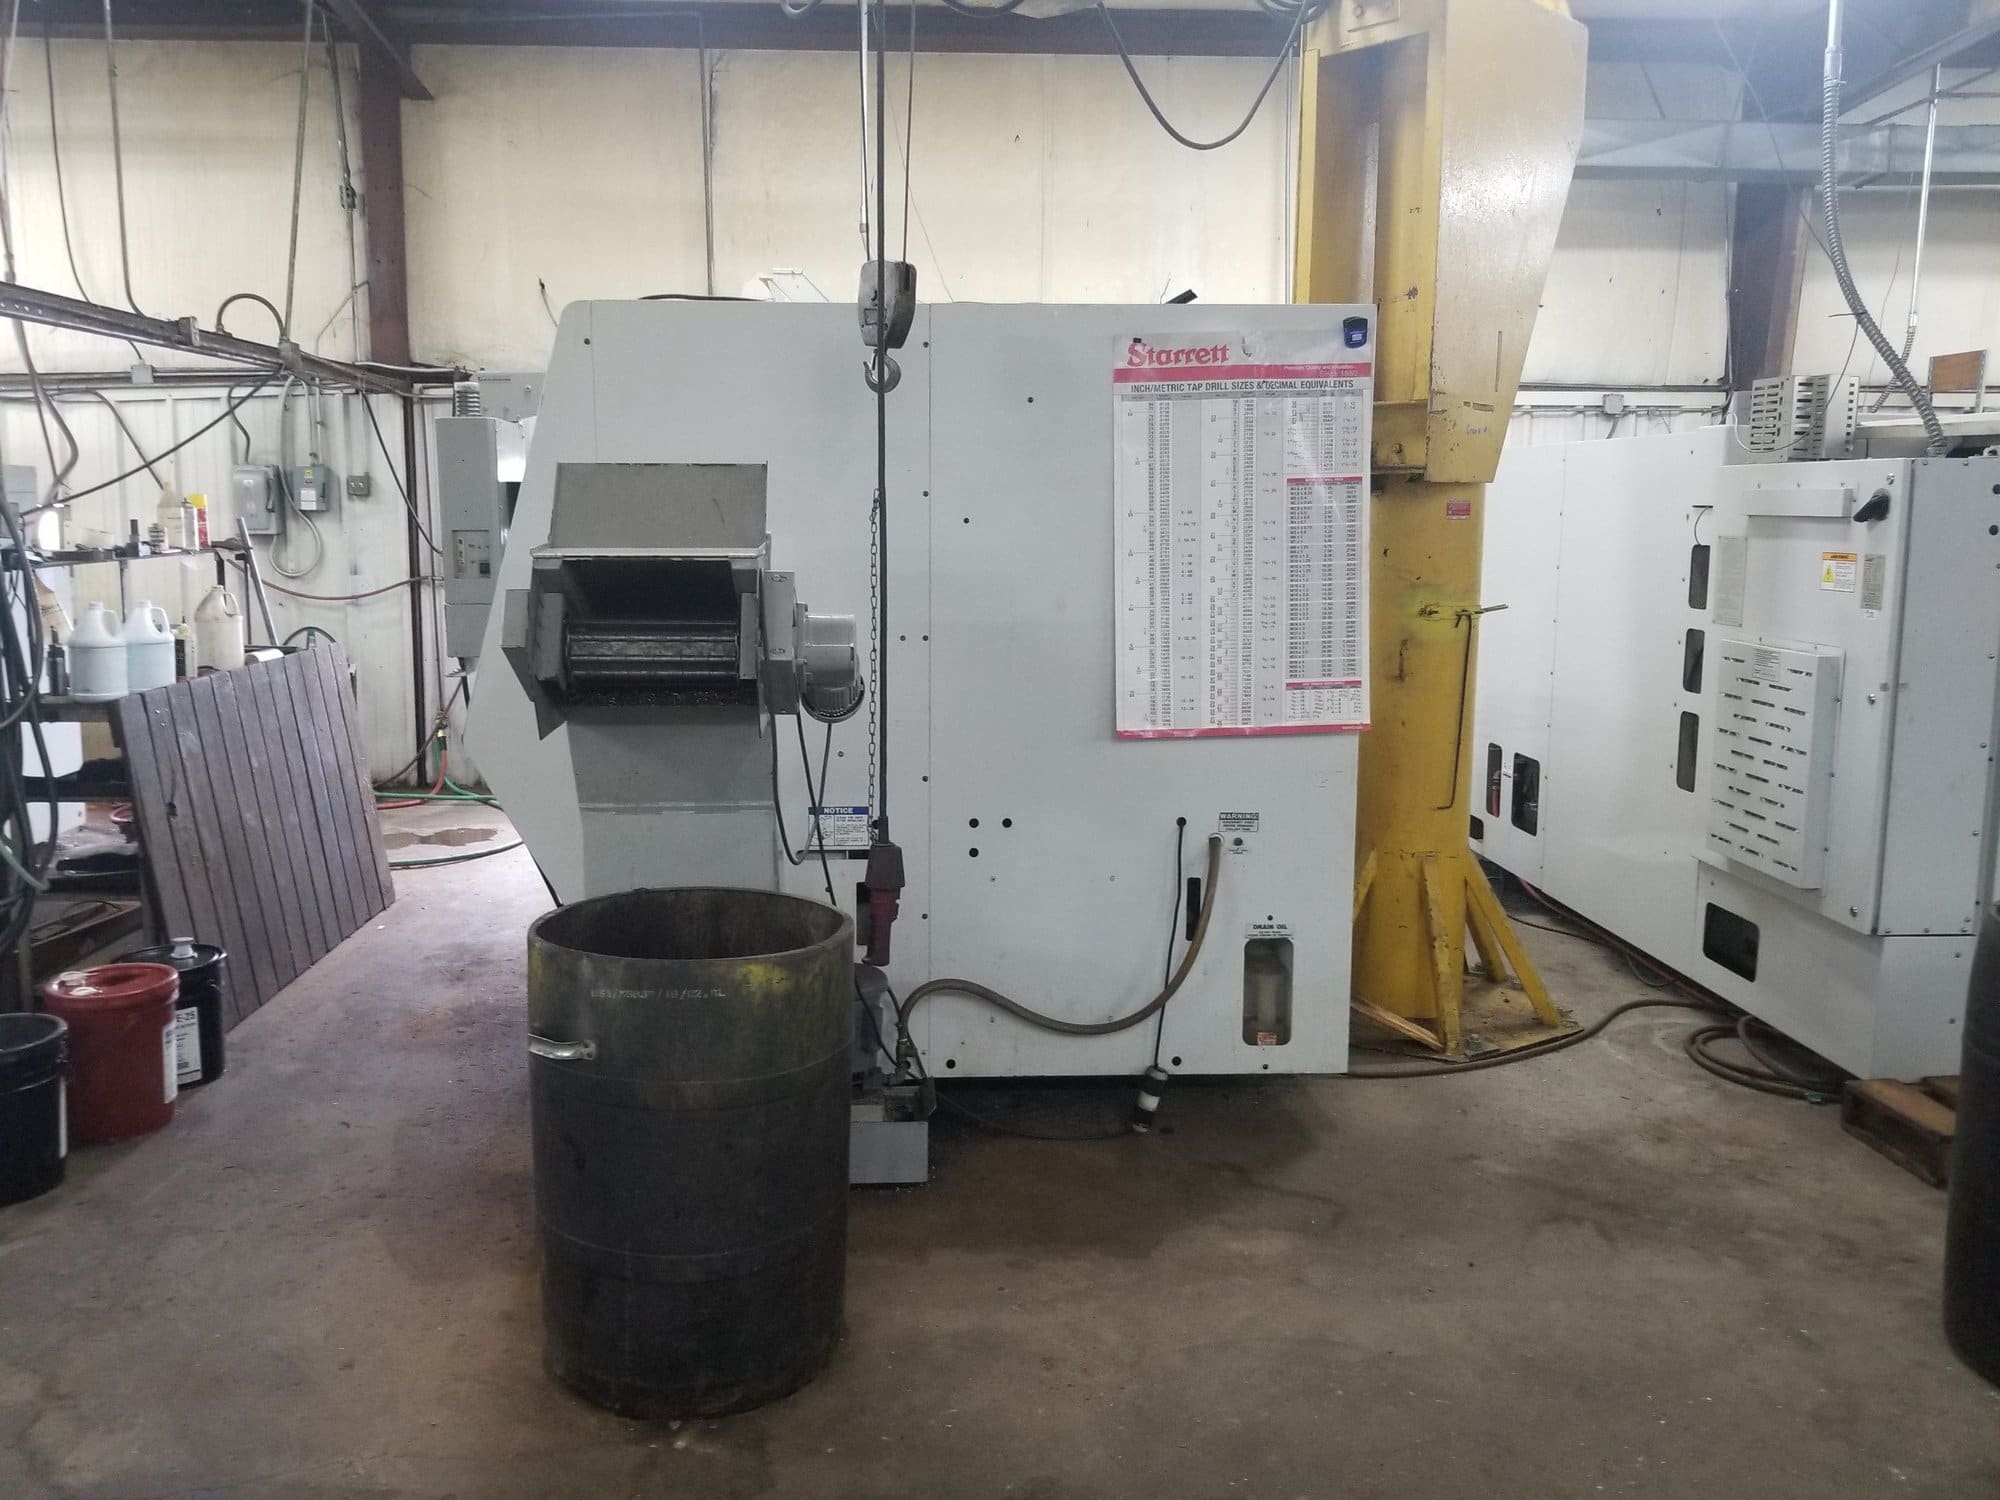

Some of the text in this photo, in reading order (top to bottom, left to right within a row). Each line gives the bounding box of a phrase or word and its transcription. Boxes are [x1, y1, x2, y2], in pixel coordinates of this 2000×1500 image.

[1127, 341, 1229, 367] Starrett
[1131, 383, 1185, 393] INCH/METRIC
[1187, 382, 1203, 392] TAP
[1205, 381, 1229, 391] DRILL
[1231, 380, 1255, 390] SIZES
[1264, 380, 1297, 389] DECIMAL
[1300, 379, 1354, 389] EQUIVALENTS
